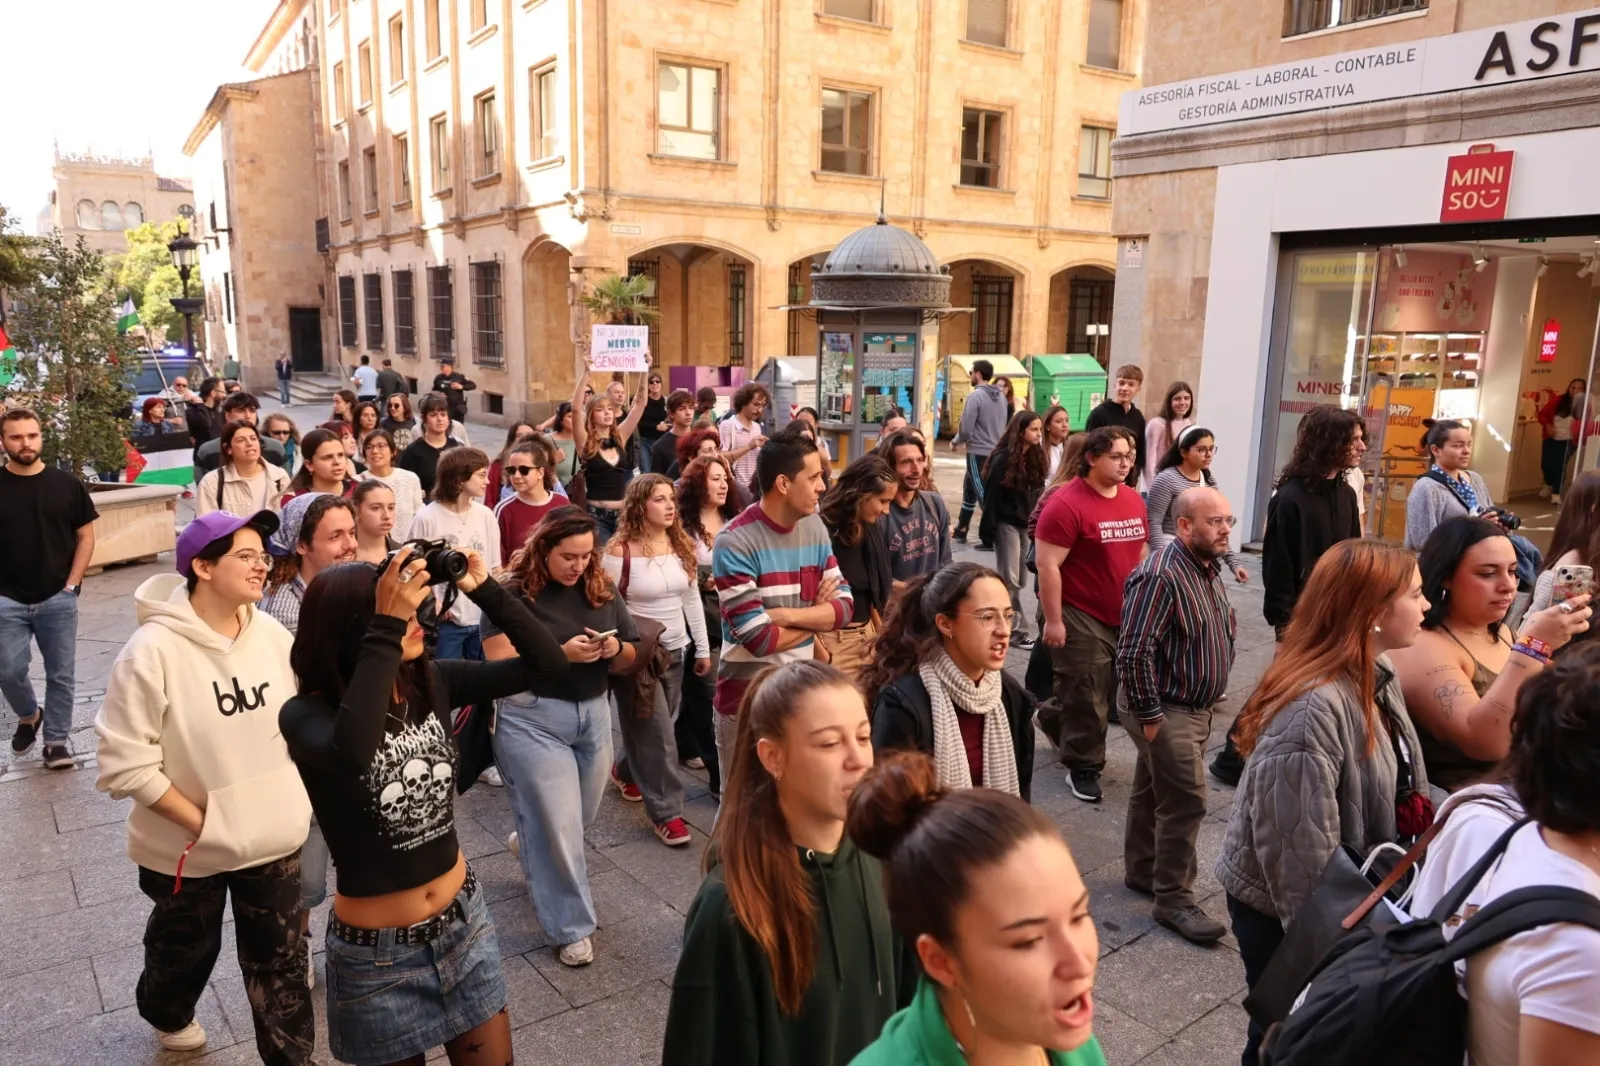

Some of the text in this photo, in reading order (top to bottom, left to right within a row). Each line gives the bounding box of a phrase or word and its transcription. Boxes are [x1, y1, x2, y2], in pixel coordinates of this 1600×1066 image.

[1139, 85, 1195, 106] ASESORÍA
[1198, 79, 1241, 97] FISCAL
[1255, 65, 1319, 88] LABORAL
[1334, 48, 1417, 74] CONTABLE
[1178, 83, 1355, 121] GESTORÍA ADMINISTRATIVA
[1451, 165, 1504, 187] MINI
[1098, 517, 1142, 529] UNIVERSIDAD
[1101, 526, 1145, 539] DE MURCIA
[212, 676, 270, 717] blur
